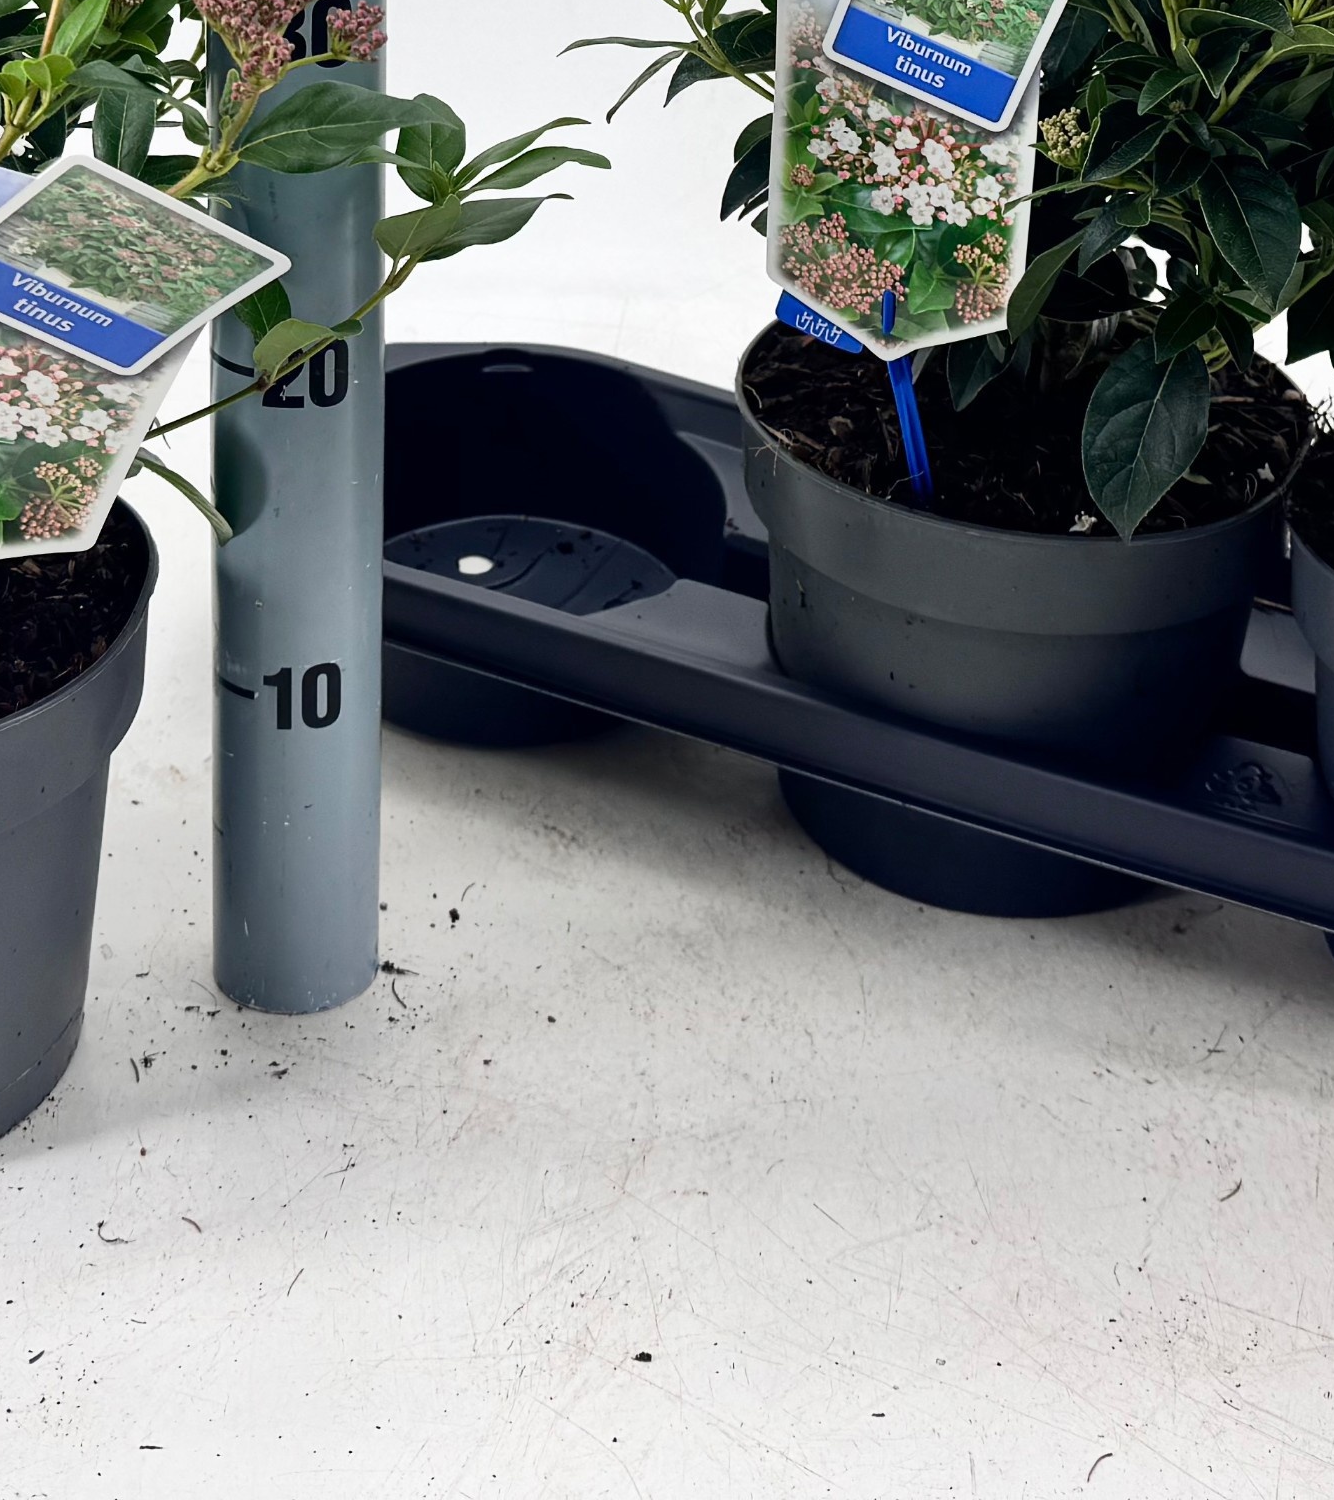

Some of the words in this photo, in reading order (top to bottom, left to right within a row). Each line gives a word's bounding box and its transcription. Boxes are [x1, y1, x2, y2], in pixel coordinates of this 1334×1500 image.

[887, 25, 972, 77] Viburnum
[894, 54, 946, 89] tinus
[11, 272, 113, 327] Viburnum
[12, 298, 75, 332] tinus
[261, 338, 349, 409] 20
[262, 662, 342, 731] 10
